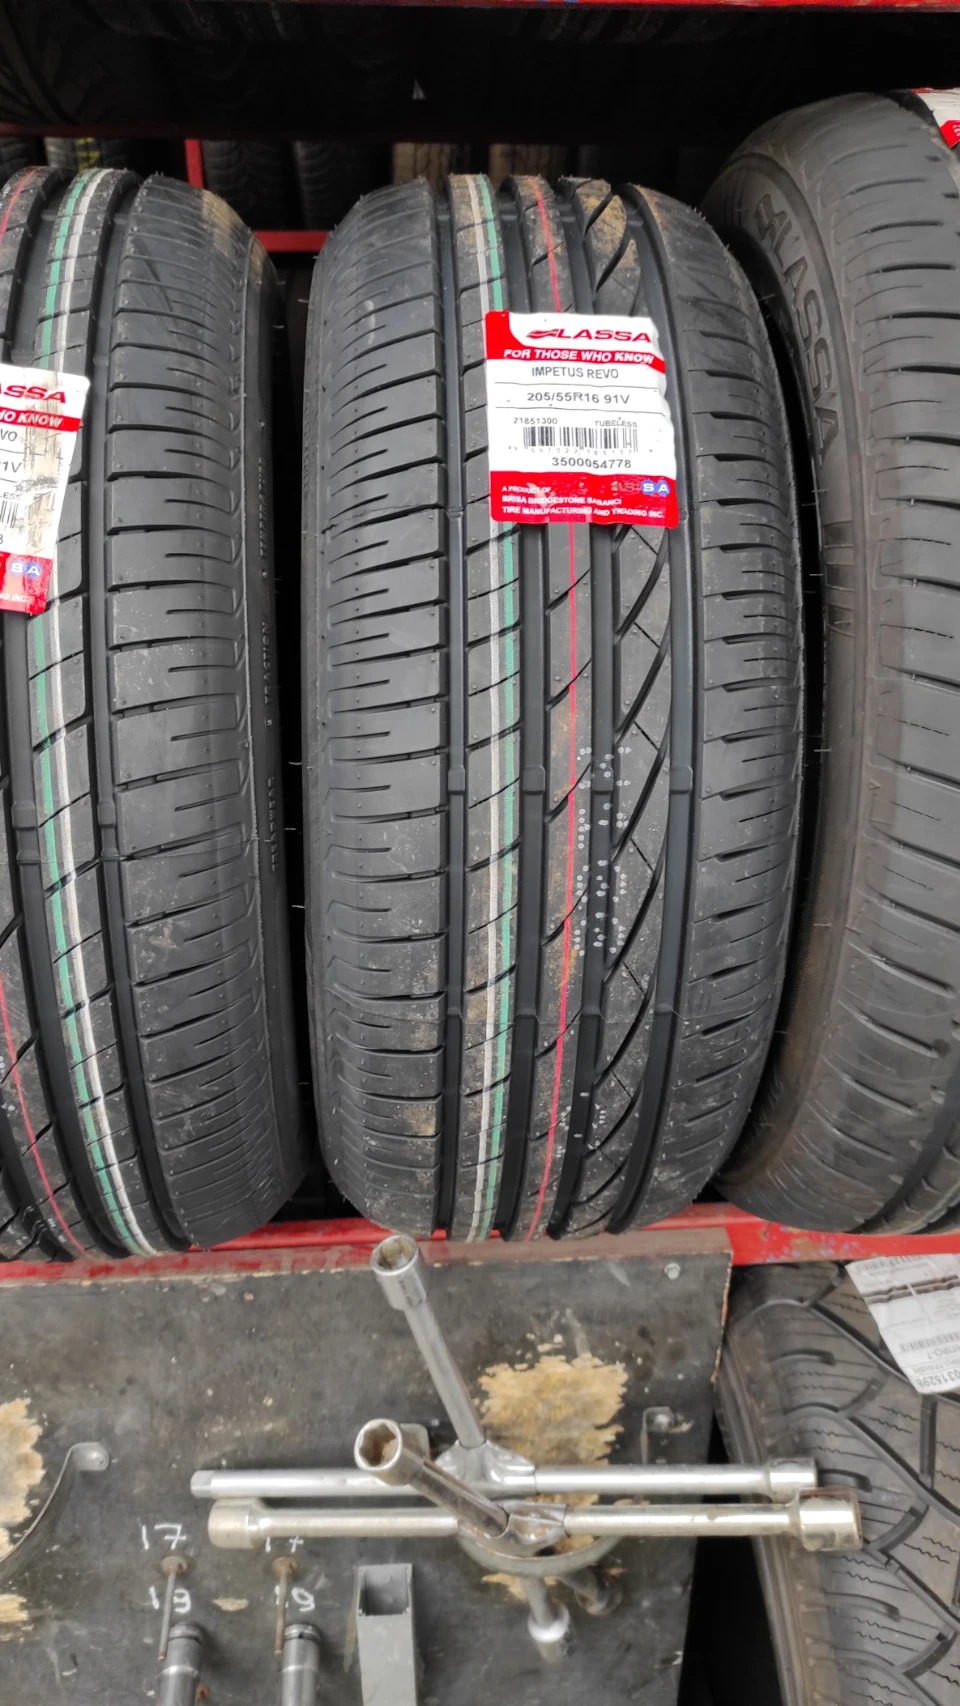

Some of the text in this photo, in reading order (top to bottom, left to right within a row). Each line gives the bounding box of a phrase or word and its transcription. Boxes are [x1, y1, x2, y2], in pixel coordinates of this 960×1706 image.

[557, 328, 652, 343] LASSA
[503, 349, 654, 364] FOR THOSE WHO KNOW
[531, 366, 619, 379] IMPETUS REVO
[0, 383, 66, 404] SSA
[526, 391, 630, 404] 205/55R16 91V
[17, 413, 63, 427] KNOW
[594, 420, 638, 428] TUBELESS
[551, 457, 632, 469] 3500054778
[502, 495, 527, 503] BRISA
[528, 496, 586, 505] BRIDGESTONE
[522, 507, 592, 515] MANUFACTURING
[593, 508, 610, 516] AND
[612, 508, 647, 517] TRADING
[142, 1523, 187, 1550] 17
